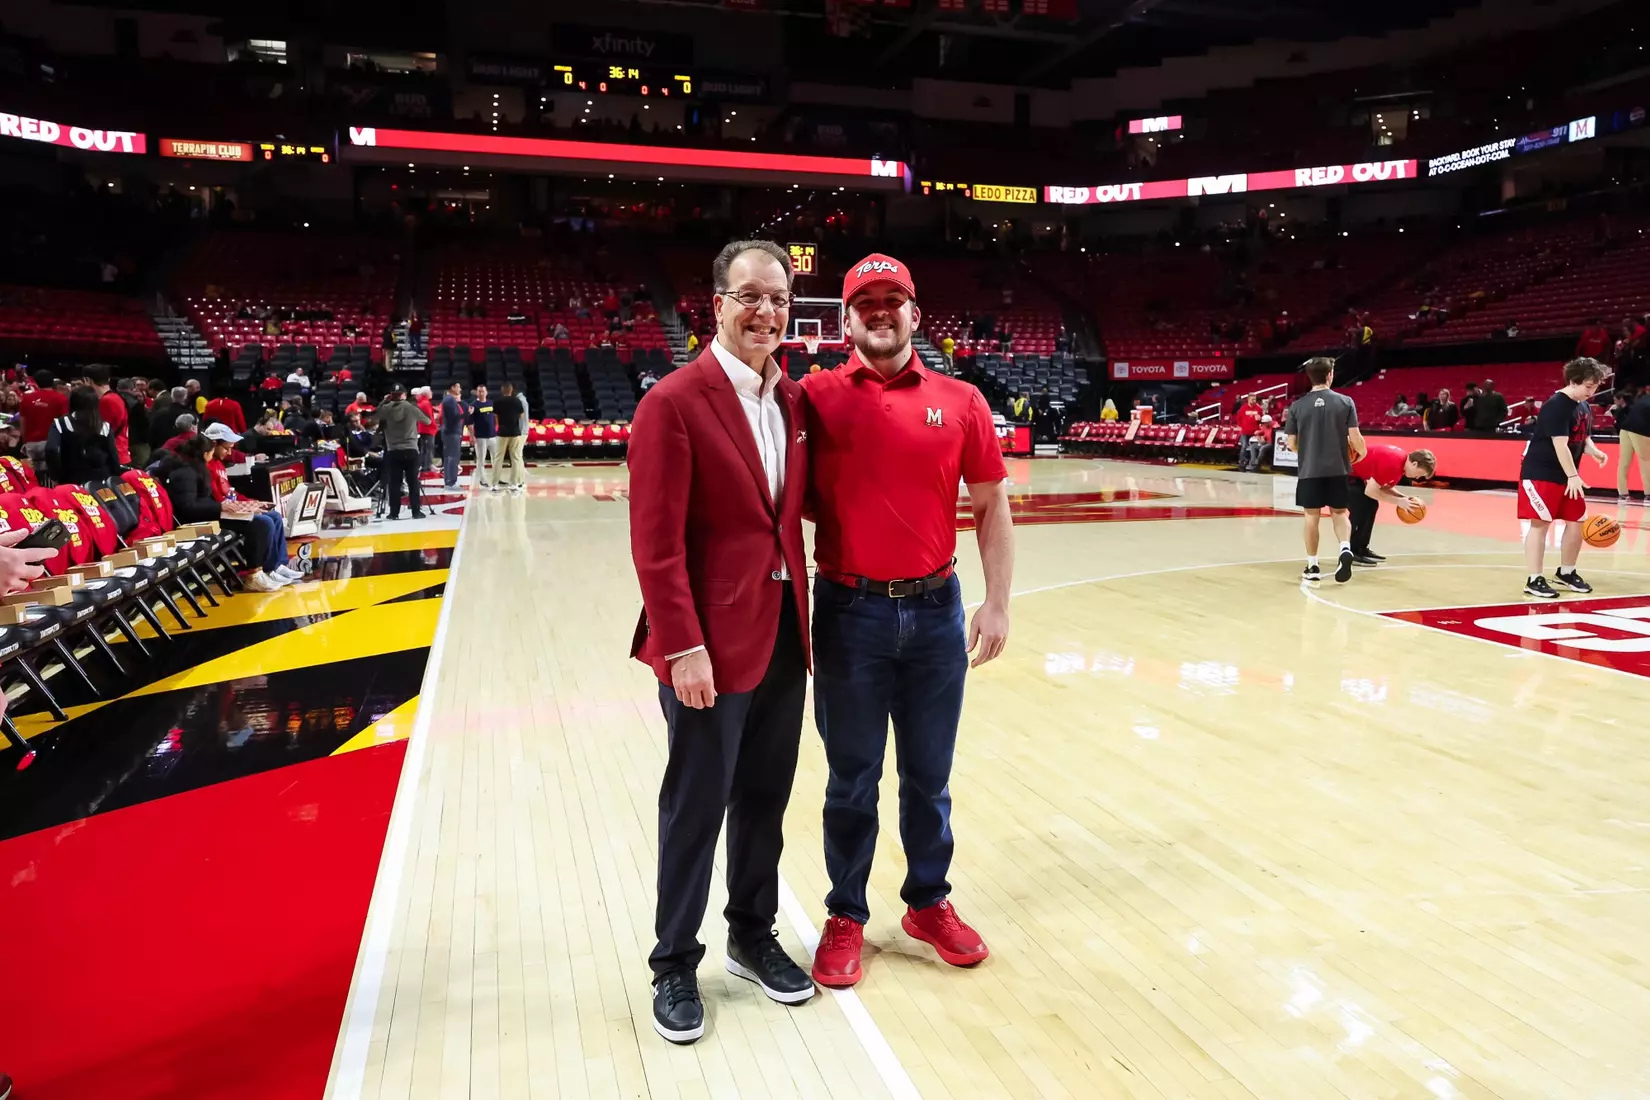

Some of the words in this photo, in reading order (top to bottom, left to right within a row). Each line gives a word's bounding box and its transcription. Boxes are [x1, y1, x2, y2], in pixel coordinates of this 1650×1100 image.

[592, 32, 656, 57] xfinity
[564, 72, 573, 84] 0
[579, 81, 586, 90] 4
[600, 82, 607, 92] 0
[641, 85, 648, 95] 0
[662, 88, 669, 96] 4
[683, 82, 691, 93] 0
[0, 112, 60, 143] RED
[69, 126, 136, 153] OUT
[1576, 119, 1588, 138] M
[172, 142, 216, 155] TERRAPIN
[218, 145, 242, 156] CLUB
[1461, 147, 1480, 159] BOOK
[1480, 142, 1499, 155] YOUR
[1499, 138, 1516, 150] STAY
[1295, 165, 1345, 187] RED
[1352, 159, 1409, 182] OUT
[1428, 167, 1438, 177] AT
[974, 186, 1001, 199] LEDO
[1004, 188, 1036, 202] PIZZA
[1049, 185, 1090, 204] RED
[1096, 182, 1144, 203] OUT
[792, 255, 812, 272] 30
[855, 260, 898, 279] Terps
[1131, 365, 1166, 374] TOYOTA
[1191, 364, 1228, 373] TOYOTA
[925, 406, 943, 426] M
[306, 494, 318, 509] M
